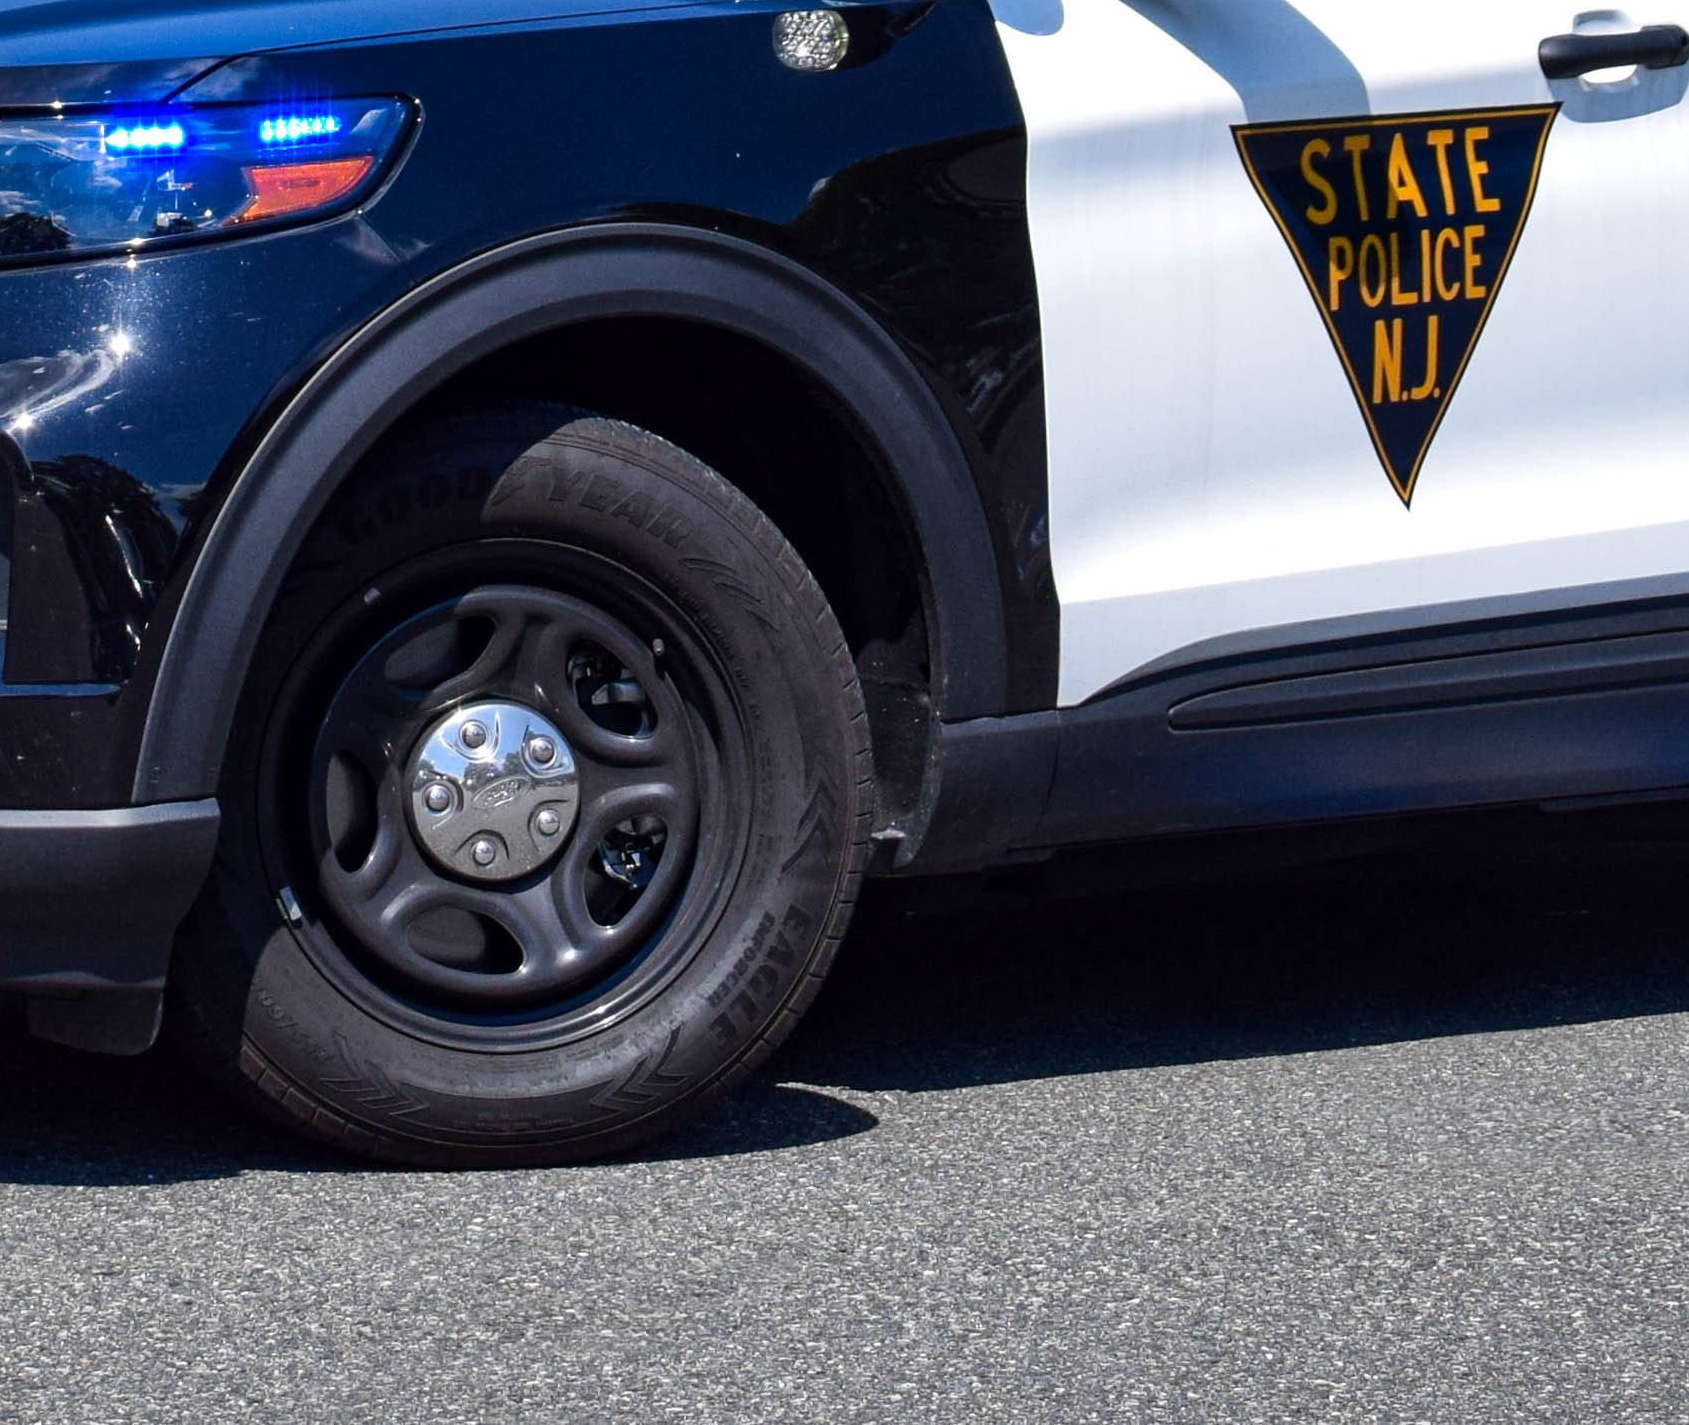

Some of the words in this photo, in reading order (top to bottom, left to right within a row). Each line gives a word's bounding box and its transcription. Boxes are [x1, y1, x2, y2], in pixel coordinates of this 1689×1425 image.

[1300, 125, 1502, 226] STATE
[1327, 224, 1488, 312] POLICE
[1371, 314, 1442, 405] N.J.
[709, 902, 813, 1050] EAGLE
